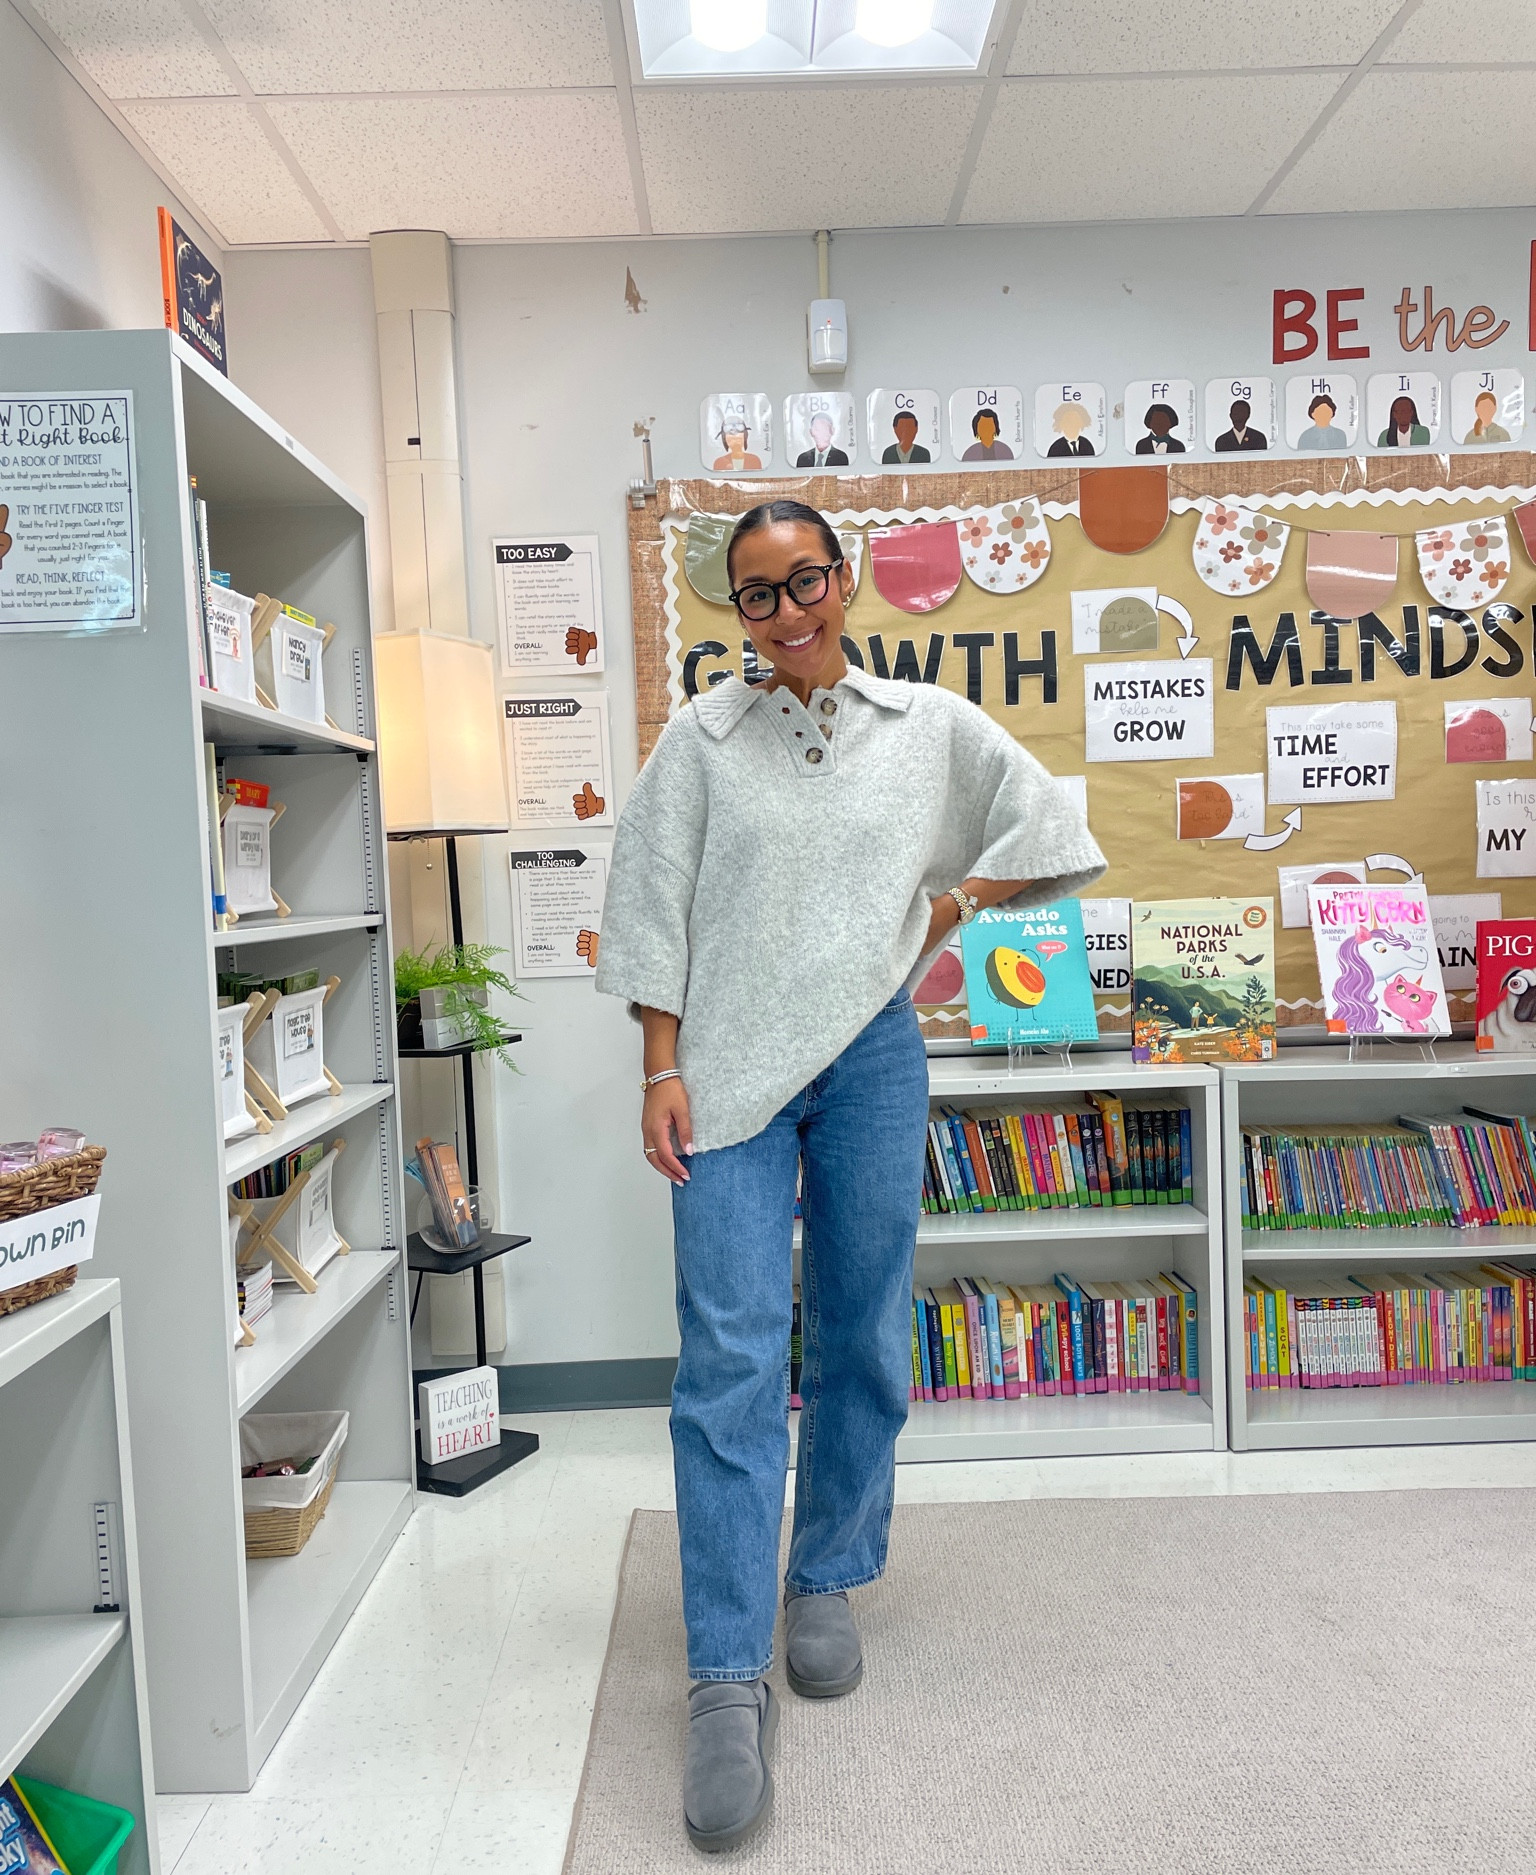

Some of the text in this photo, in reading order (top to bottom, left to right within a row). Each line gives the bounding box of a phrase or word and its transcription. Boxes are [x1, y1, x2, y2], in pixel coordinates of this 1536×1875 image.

[1272, 288, 1370, 365] BE
[1393, 286, 1511, 352] the
[182, 307, 223, 361] DINOSAURS
[1311, 378, 1331, 394] Hh
[1479, 372, 1495, 392] Jj
[977, 390, 997, 406] Dd
[1062, 385, 1082, 402] Ee
[1152, 383, 1170, 399] Ff
[1230, 381, 1252, 400] Gg
[725, 399, 745, 414] Aa
[811, 396, 830, 412] Bb
[893, 393, 915, 409] Cc
[18, 403, 116, 426] TO FIND A
[17, 426, 125, 449] Right Book
[12, 453, 102, 467] A BOOK OF INTEREST
[16, 501, 124, 516] TRY THE FIVE FINGER TEST
[501, 547, 558, 560] TOO EASY
[16, 570, 105, 585] READ, THINK, REFLECT
[1225, 602, 1536, 691] MINDS
[1093, 678, 1206, 701] MISTAKES
[507, 702, 575, 715] JUST RIGHT
[1119, 701, 1178, 717] help me
[1113, 719, 1186, 743] GROW
[1281, 719, 1385, 733] This may take some
[1273, 733, 1338, 757] TIME
[1324, 752, 1350, 764] and
[1302, 764, 1390, 789] EFFORT
[1485, 790, 1536, 806] Is this
[1485, 828, 1527, 852] MY
[515, 858, 577, 869] CHALLENGING
[536, 851, 554, 861] TOO
[977, 908, 1060, 924] Avocado
[1373, 900, 1427, 925] CORN
[1433, 915, 1470, 926] going to
[1021, 922, 1069, 937] Asks
[1161, 923, 1244, 940] NATIONAL
[1176, 939, 1228, 954] PARKS
[1486, 934, 1535, 957] PIG
[1189, 954, 1215, 965] of the
[1181, 965, 1226, 979] U.S.A.
[1042, 1154, 1053, 1180] MATILDA
[955, 1331, 966, 1371] big game
[975, 1355, 980, 1363] AN
[947, 1358, 952, 1366] up
[434, 1378, 493, 1414] TEACHING
[456, 1404, 479, 1424] work
[480, 1402, 490, 1421] of
[436, 1420, 495, 1457] HEART
